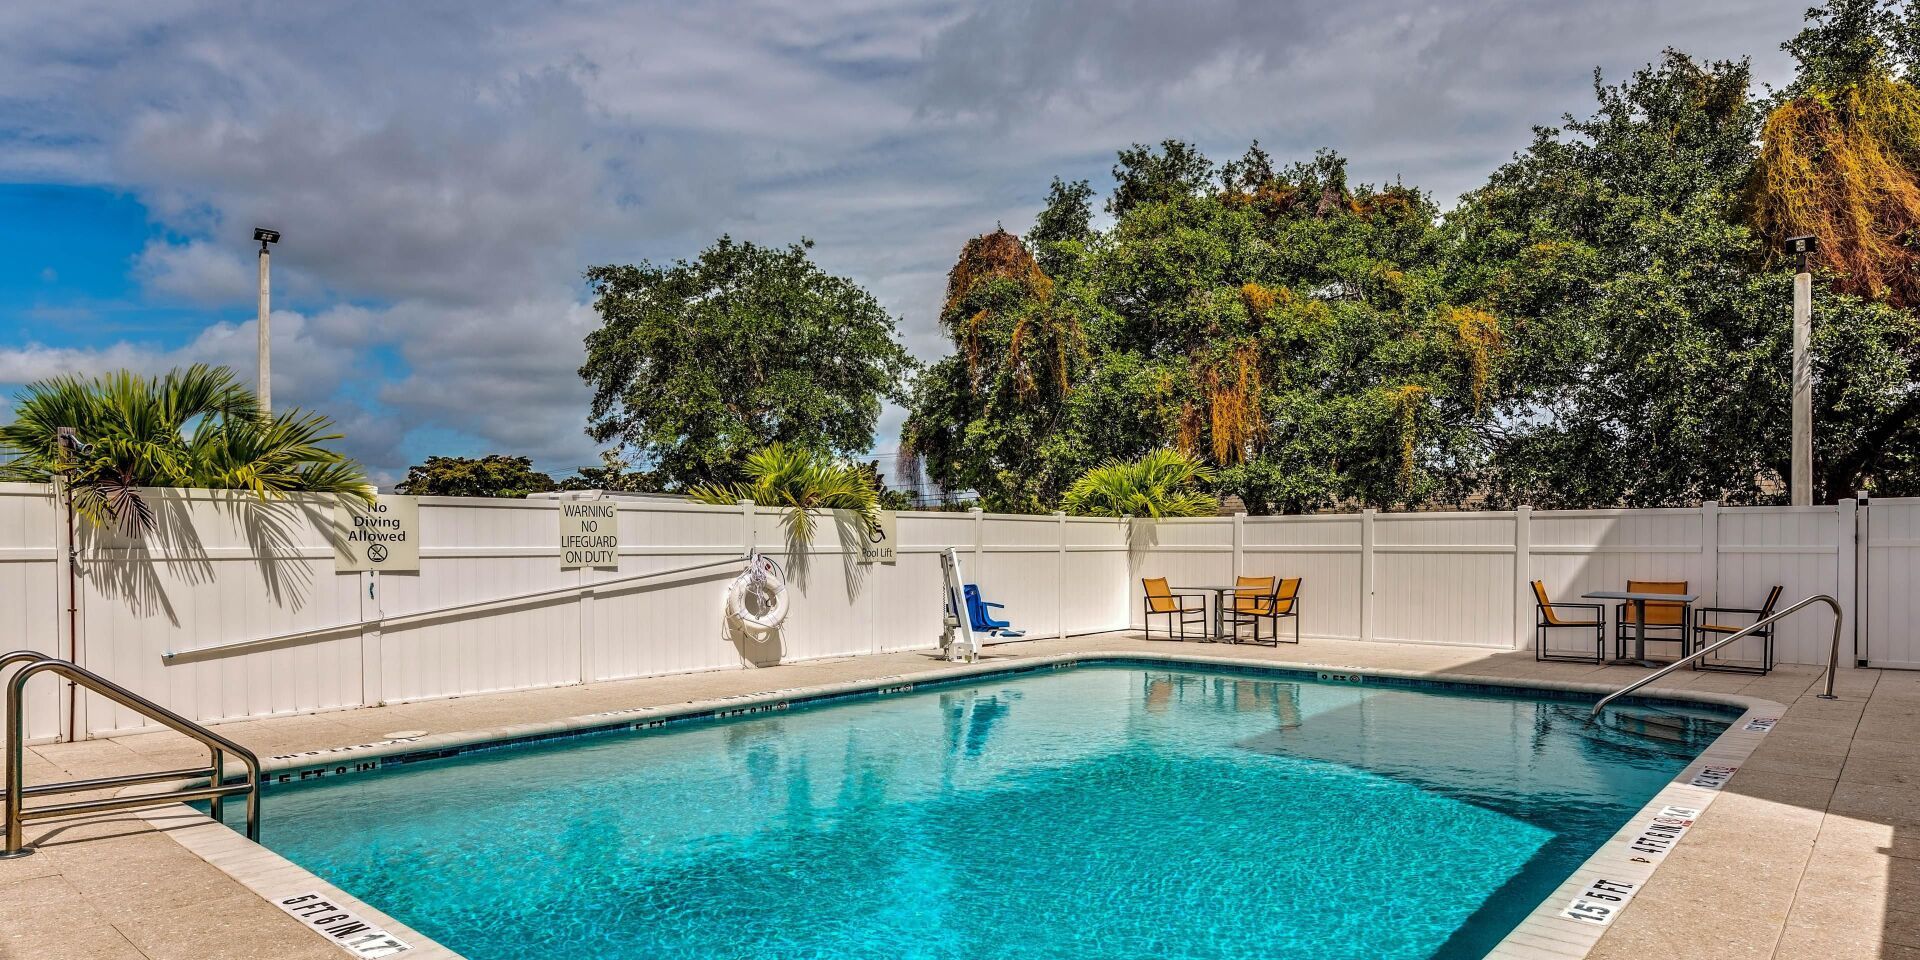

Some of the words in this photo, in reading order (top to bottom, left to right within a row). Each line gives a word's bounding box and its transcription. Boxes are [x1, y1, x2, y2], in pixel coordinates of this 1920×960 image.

[368, 502, 387, 513] No
[563, 504, 614, 518] WARNING
[354, 516, 400, 531] Diving
[581, 520, 598, 533] NO
[348, 530, 406, 542] Allowed
[561, 535, 618, 548] LIFEGUARD
[565, 550, 582, 563] ON
[585, 550, 614, 563] DUTY
[862, 547, 879, 558] Pool
[880, 547, 893, 558] Lift
